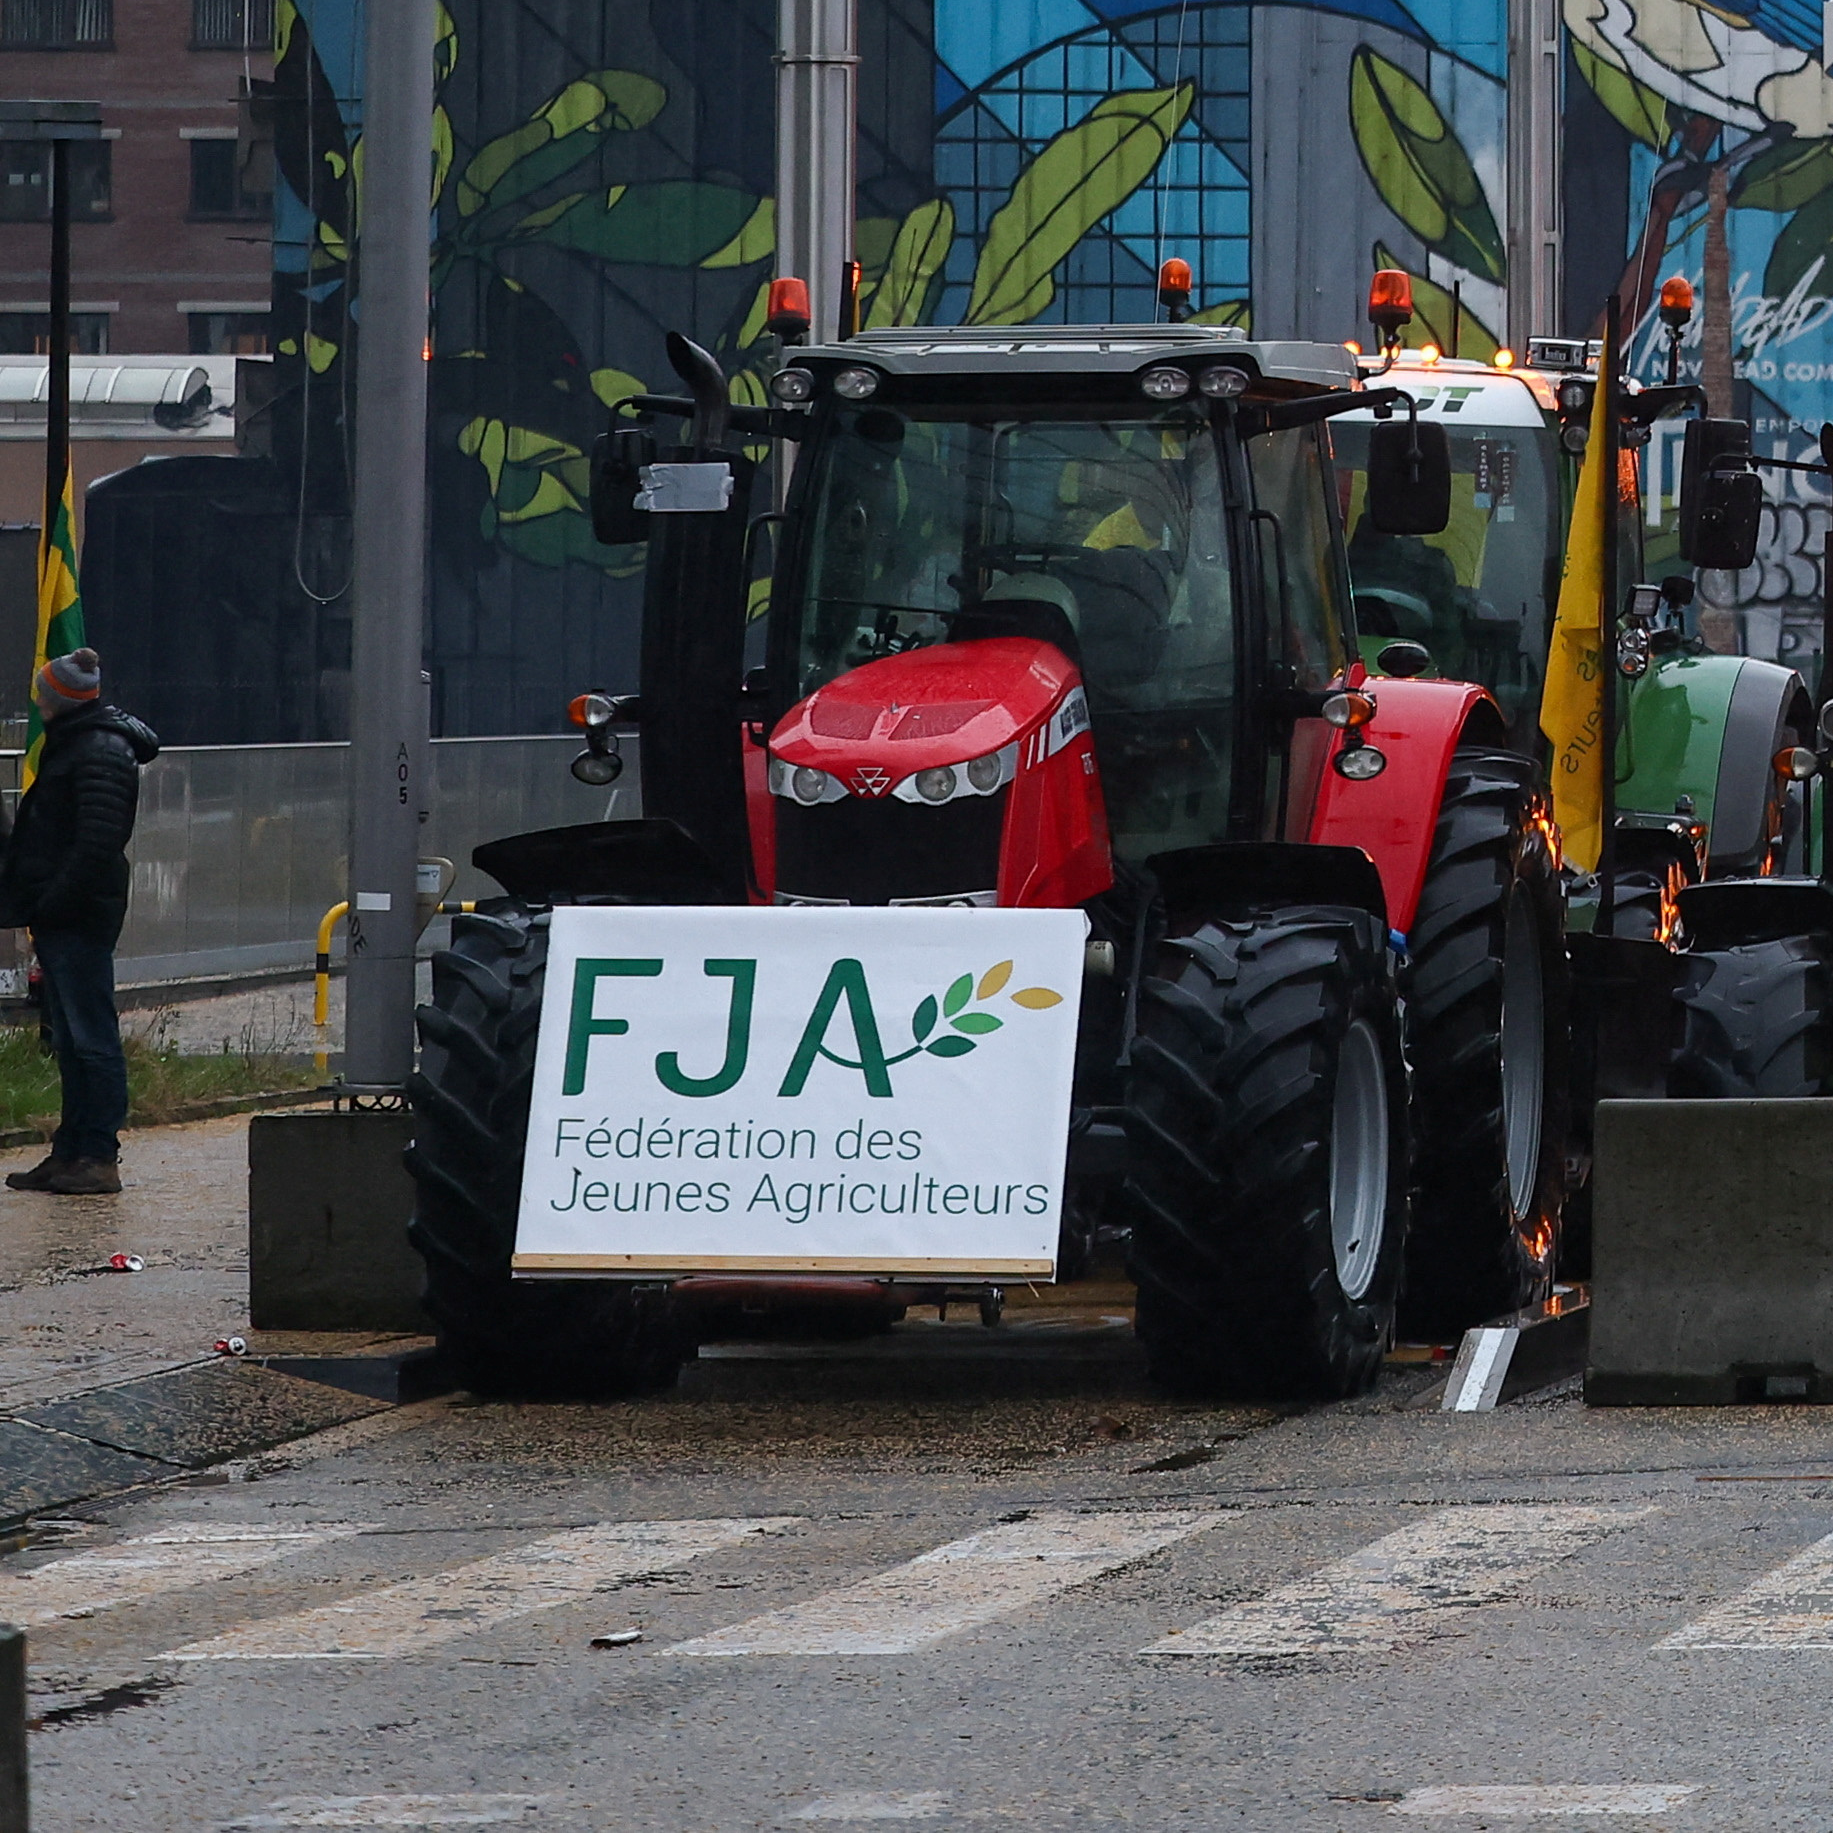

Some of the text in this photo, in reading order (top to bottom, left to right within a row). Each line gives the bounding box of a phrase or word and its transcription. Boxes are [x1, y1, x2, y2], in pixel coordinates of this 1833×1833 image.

[562, 957, 893, 1098] FJA
[554, 1117, 923, 1161] Fédération des
[550, 1169, 1050, 1224] Jeunes Agriculteurs
